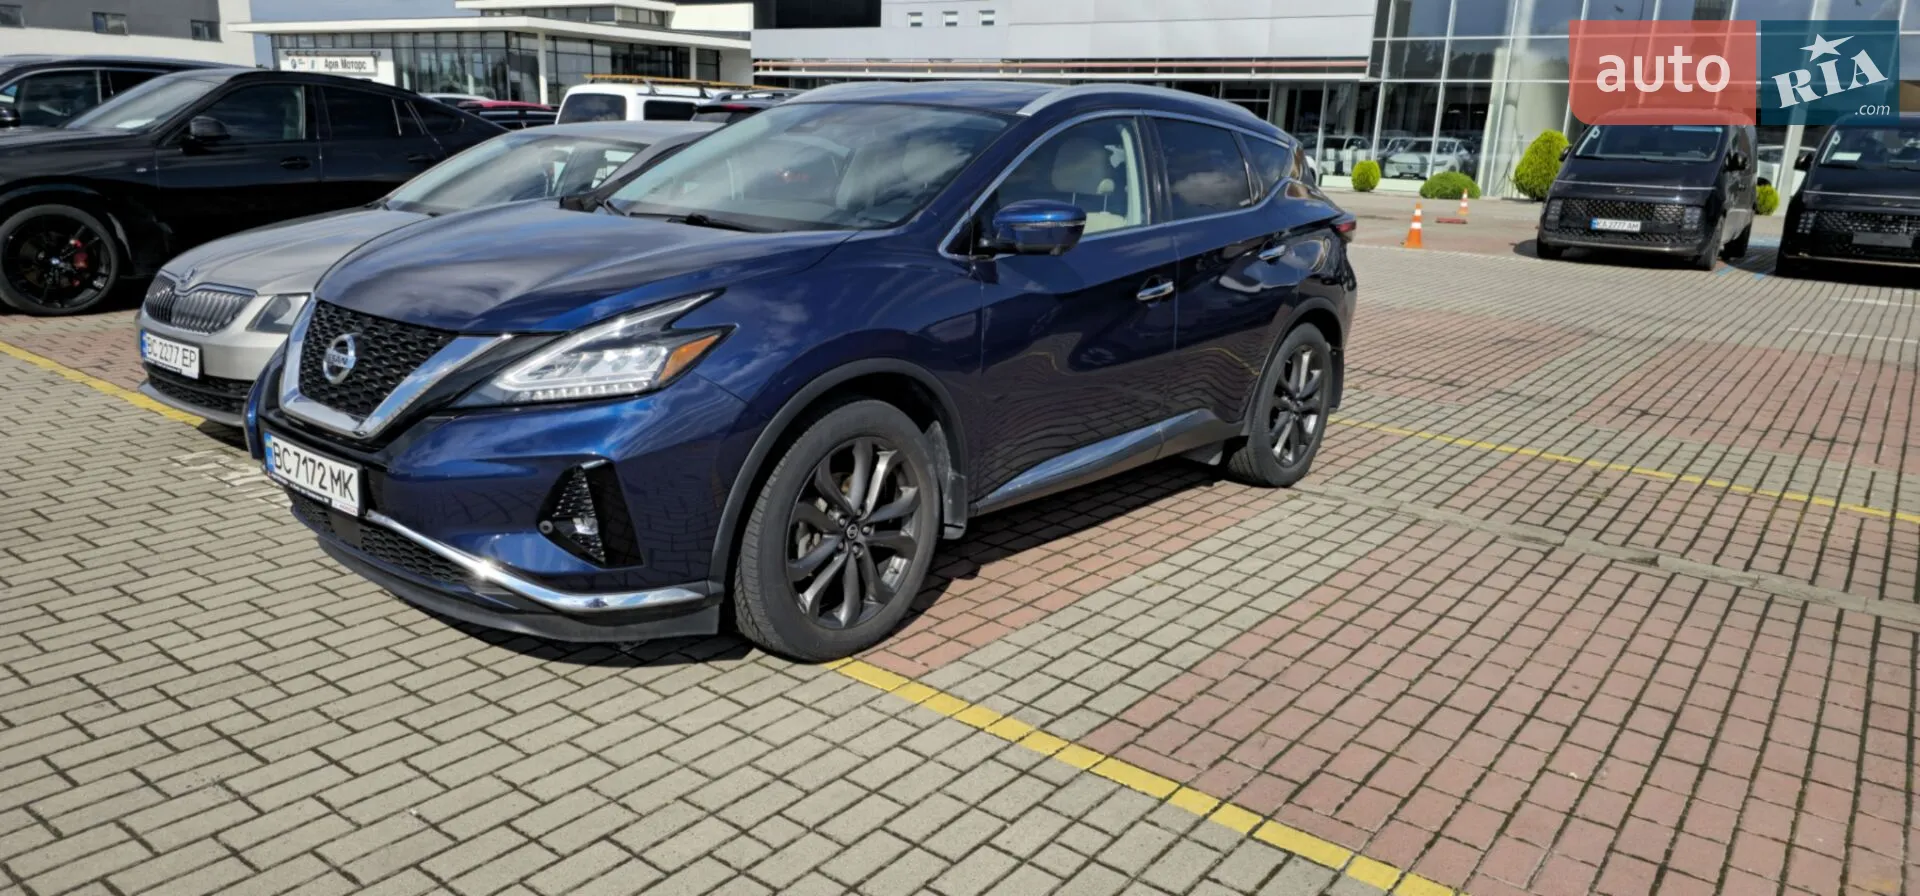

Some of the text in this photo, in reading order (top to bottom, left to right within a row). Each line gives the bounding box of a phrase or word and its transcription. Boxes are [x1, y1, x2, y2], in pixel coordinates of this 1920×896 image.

[159, 341, 180, 364] 2277
[182, 347, 197, 368] EP
[272, 441, 292, 475] BC
[293, 451, 328, 491] 7172
[329, 465, 355, 502] MK
